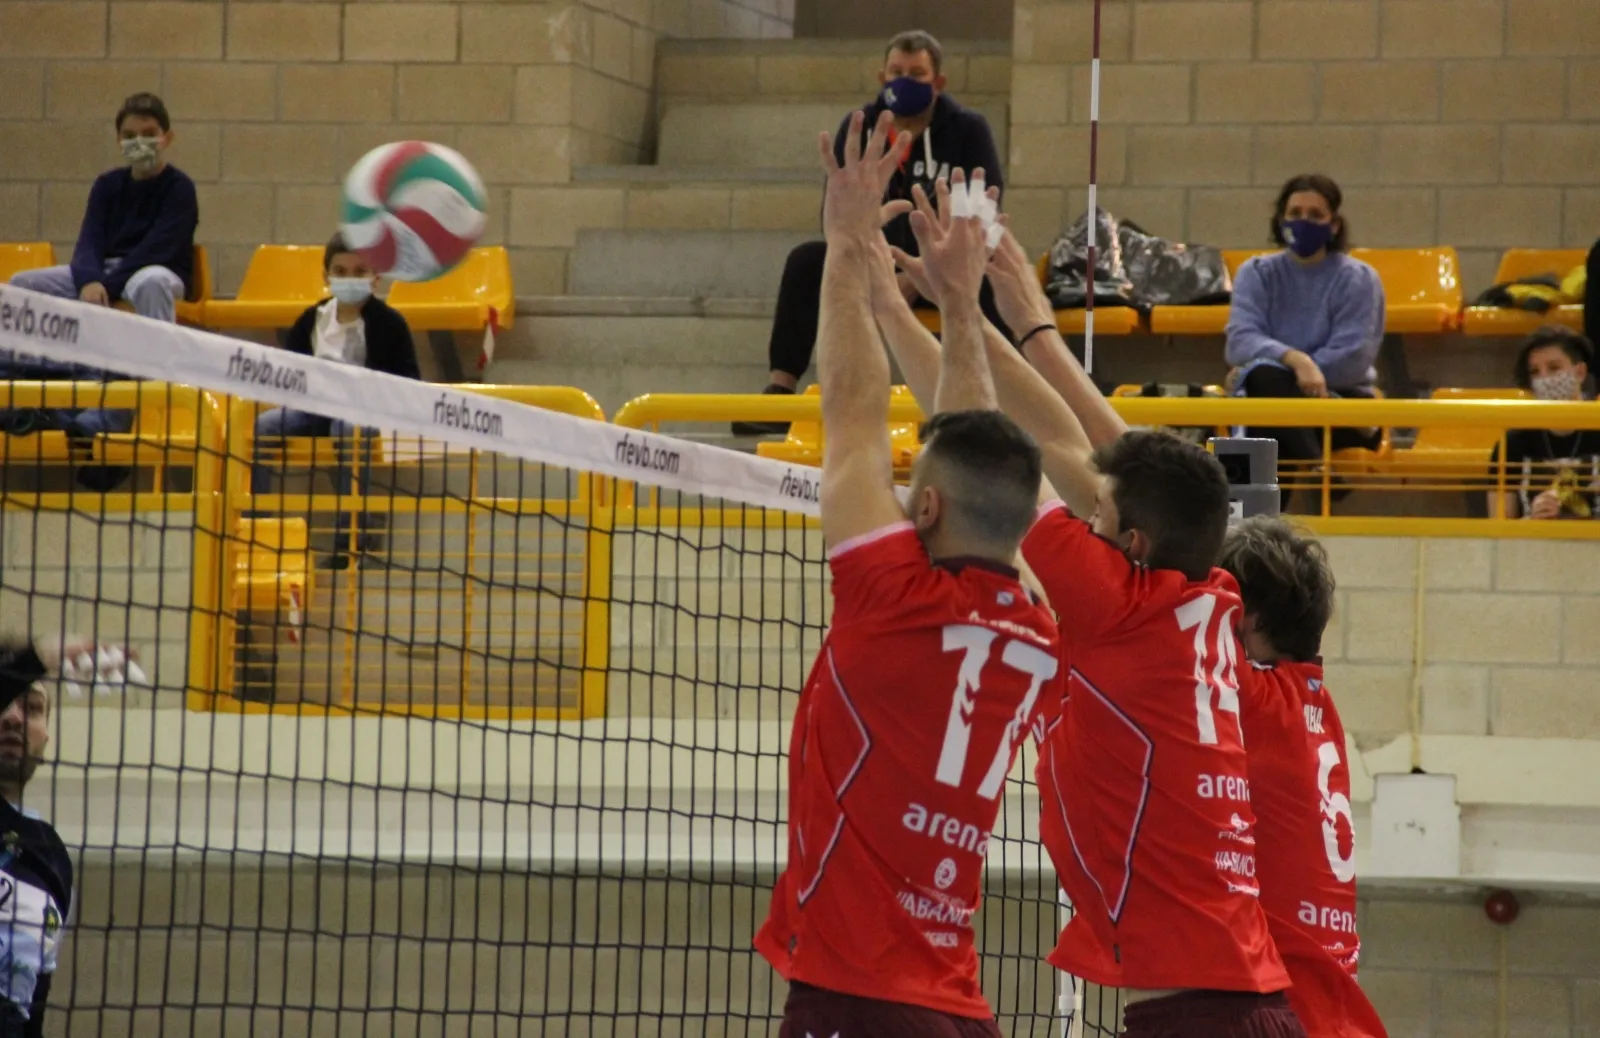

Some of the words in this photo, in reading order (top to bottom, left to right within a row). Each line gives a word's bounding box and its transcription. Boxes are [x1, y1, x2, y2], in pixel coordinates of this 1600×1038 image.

[0, 296, 79, 344] evb.com
[227, 348, 308, 394] rfevb.com
[433, 392, 503, 437] rfevb.com
[616, 432, 680, 474] rfevb.com
[780, 467, 820, 502] rfevb.c
[1174, 592, 1244, 752] 14
[935, 624, 1058, 800] 17
[1318, 741, 1356, 883] 6
